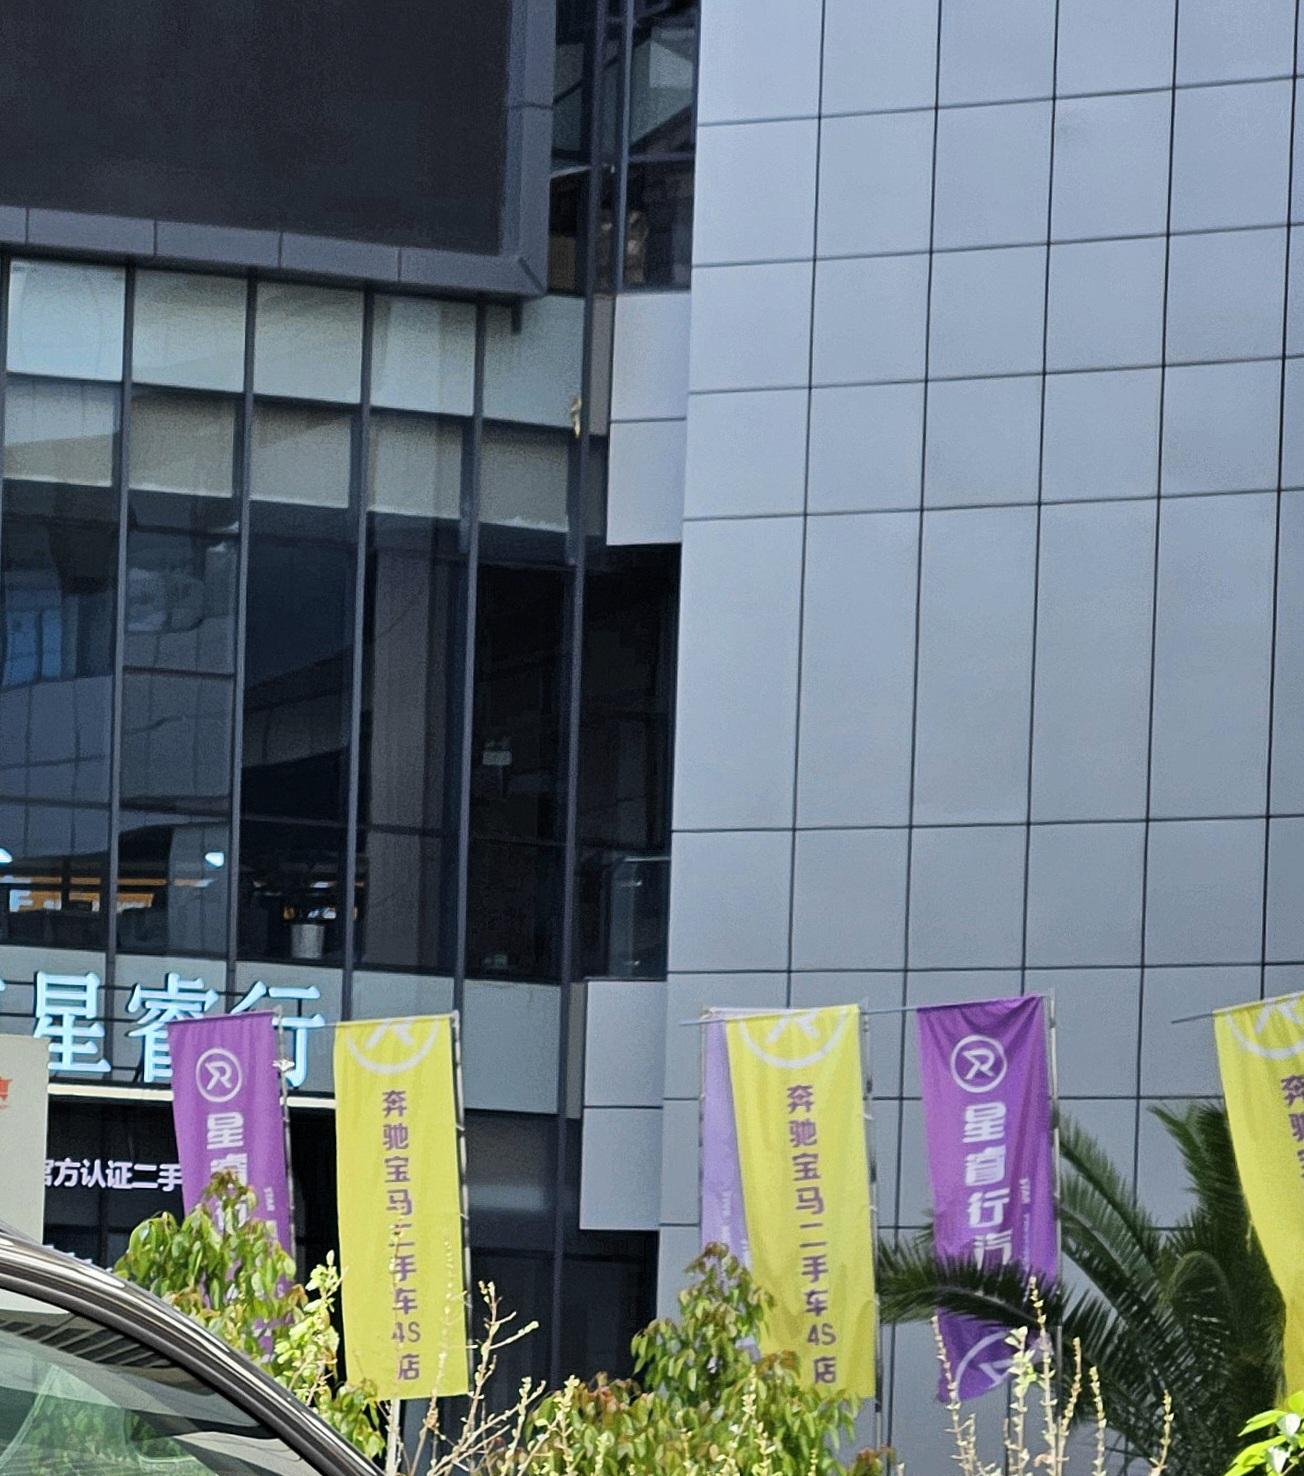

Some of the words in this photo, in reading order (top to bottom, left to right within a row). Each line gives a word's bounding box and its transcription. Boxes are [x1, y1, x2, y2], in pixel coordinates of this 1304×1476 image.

[381, 1089, 423, 1382] 奔驰宝马二手车4S店
[786, 1084, 838, 1385] 奔驰宝马二手车4S店
[1280, 1073, 1304, 1178] 奔驰
